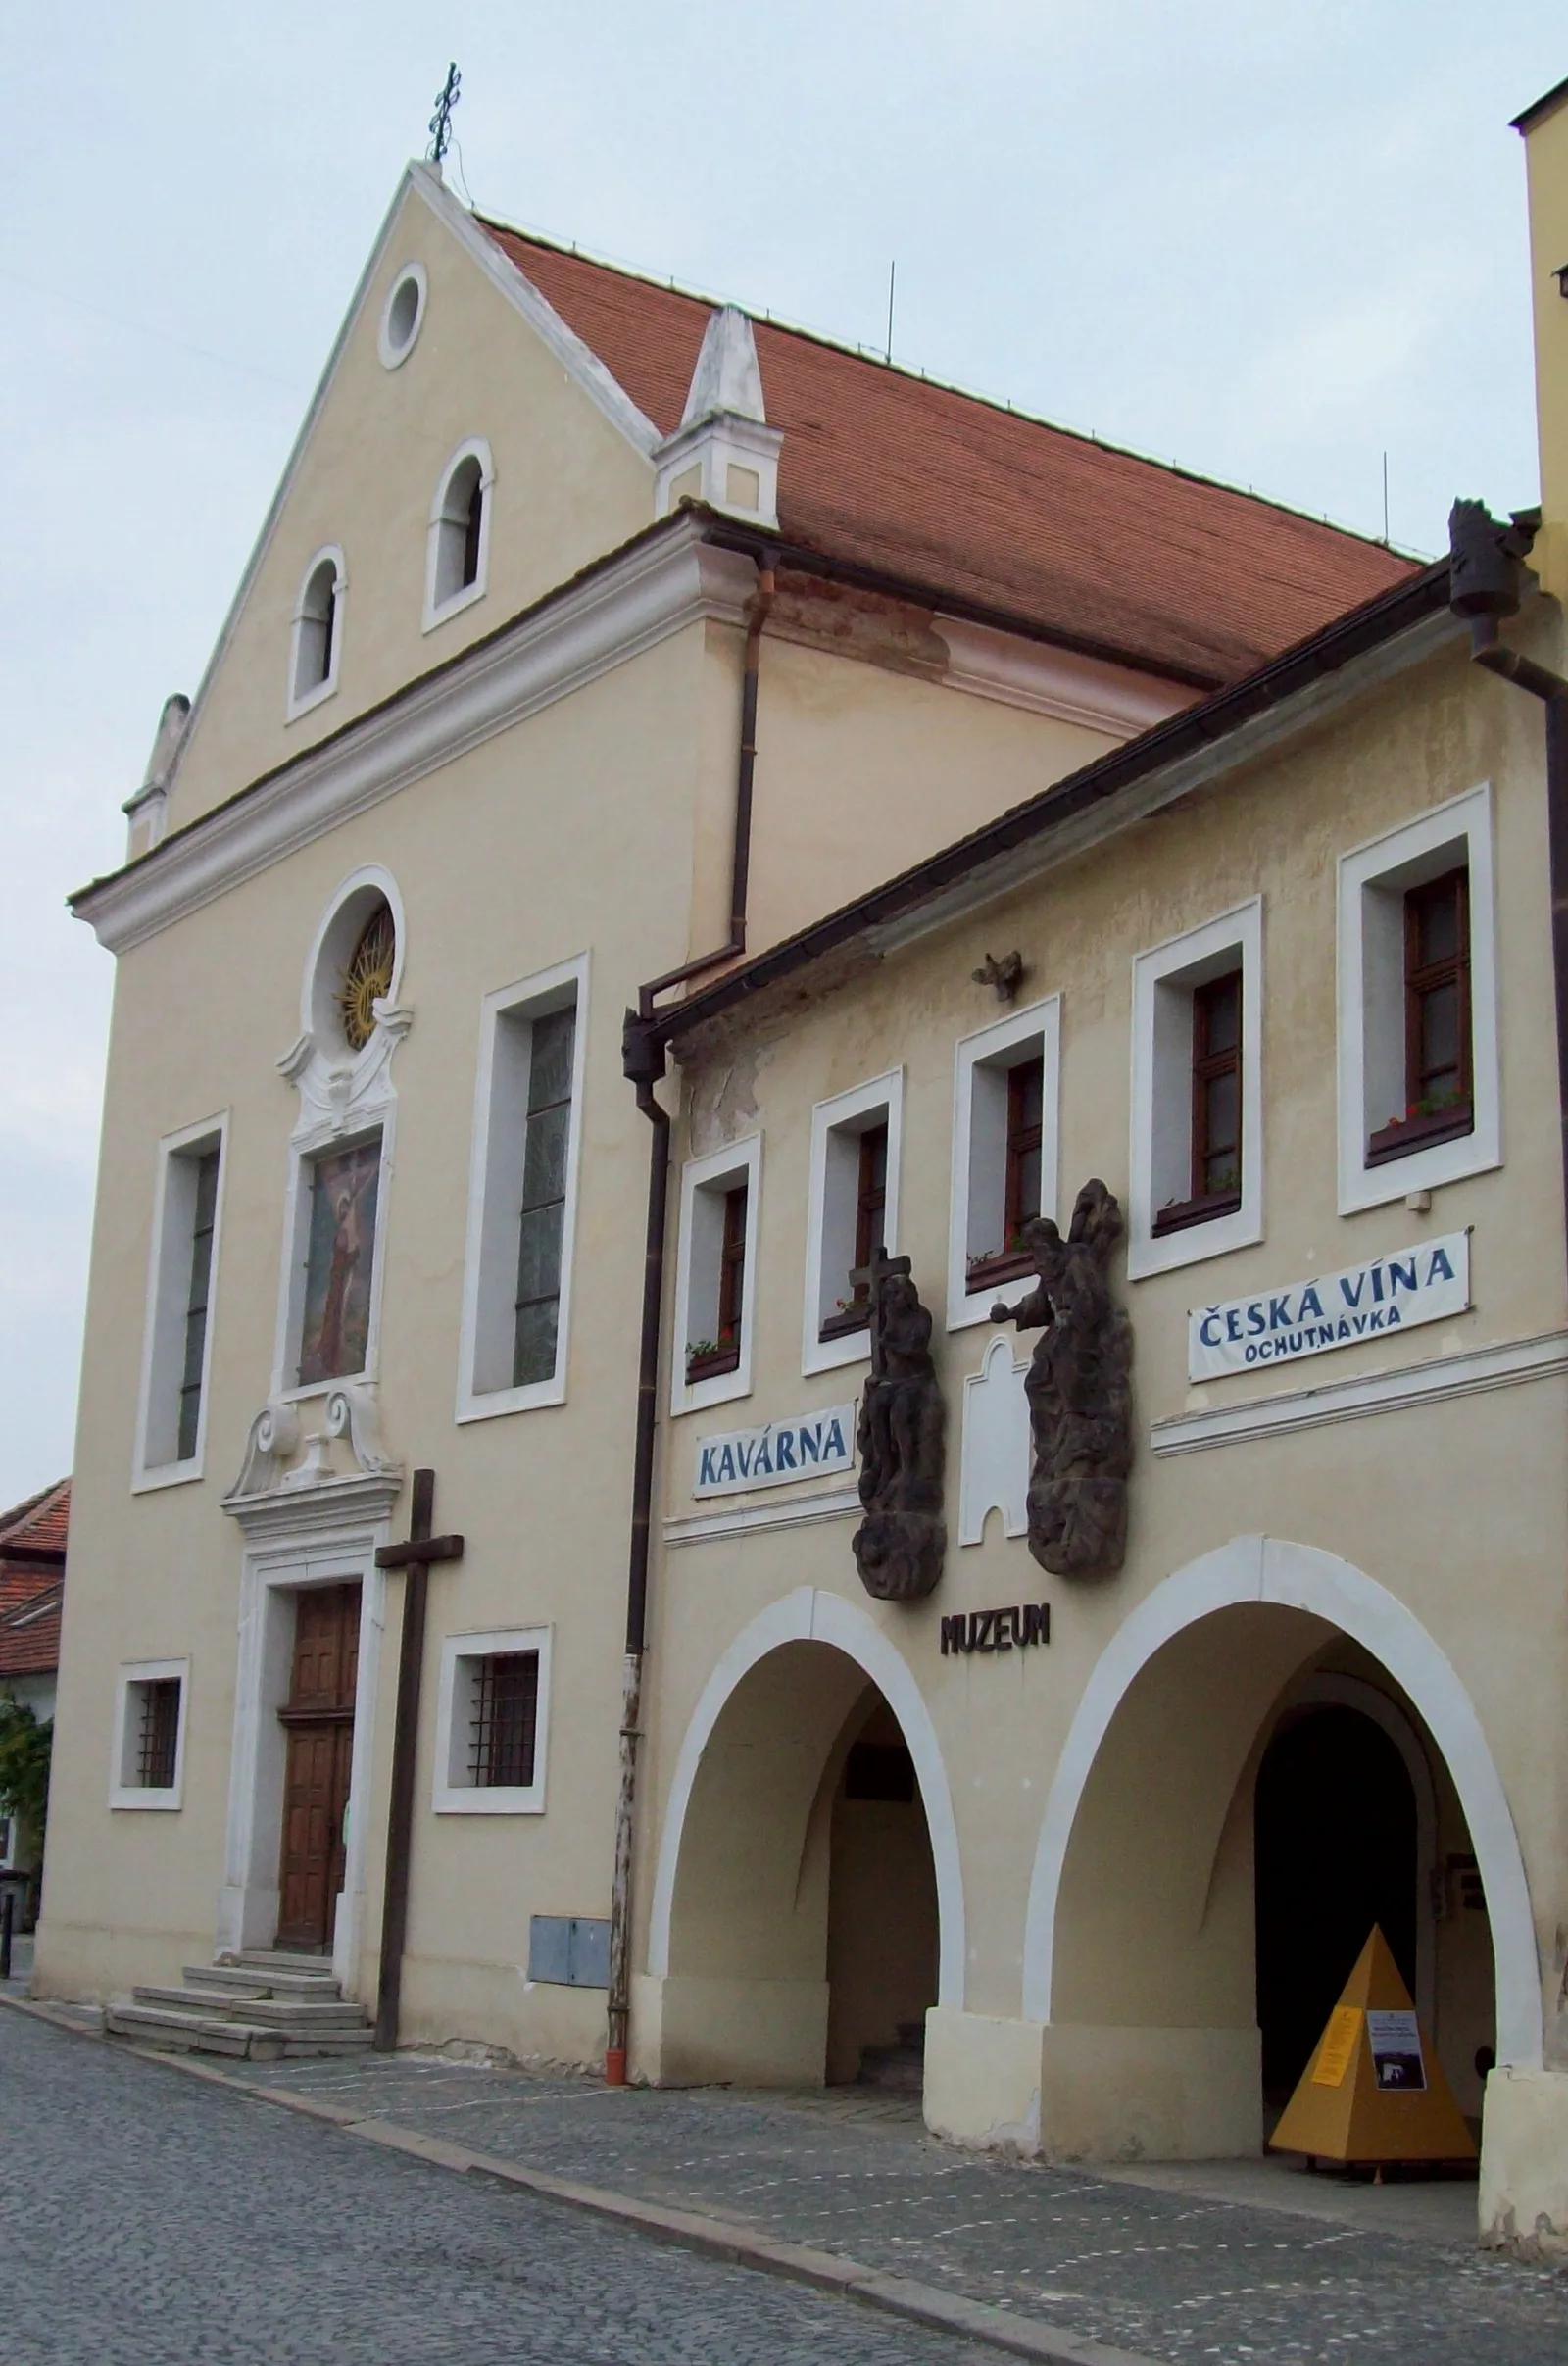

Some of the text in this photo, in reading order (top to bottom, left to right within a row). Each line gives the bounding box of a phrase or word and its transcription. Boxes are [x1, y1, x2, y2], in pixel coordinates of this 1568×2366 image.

[1200, 1248, 1456, 1347] ČESKÁ VÍNA
[1245, 1305, 1402, 1363] OCHUTNÁVKA
[699, 1418, 847, 1486] KAVÁRNA
[940, 1602, 1051, 1655] MUZEUM
